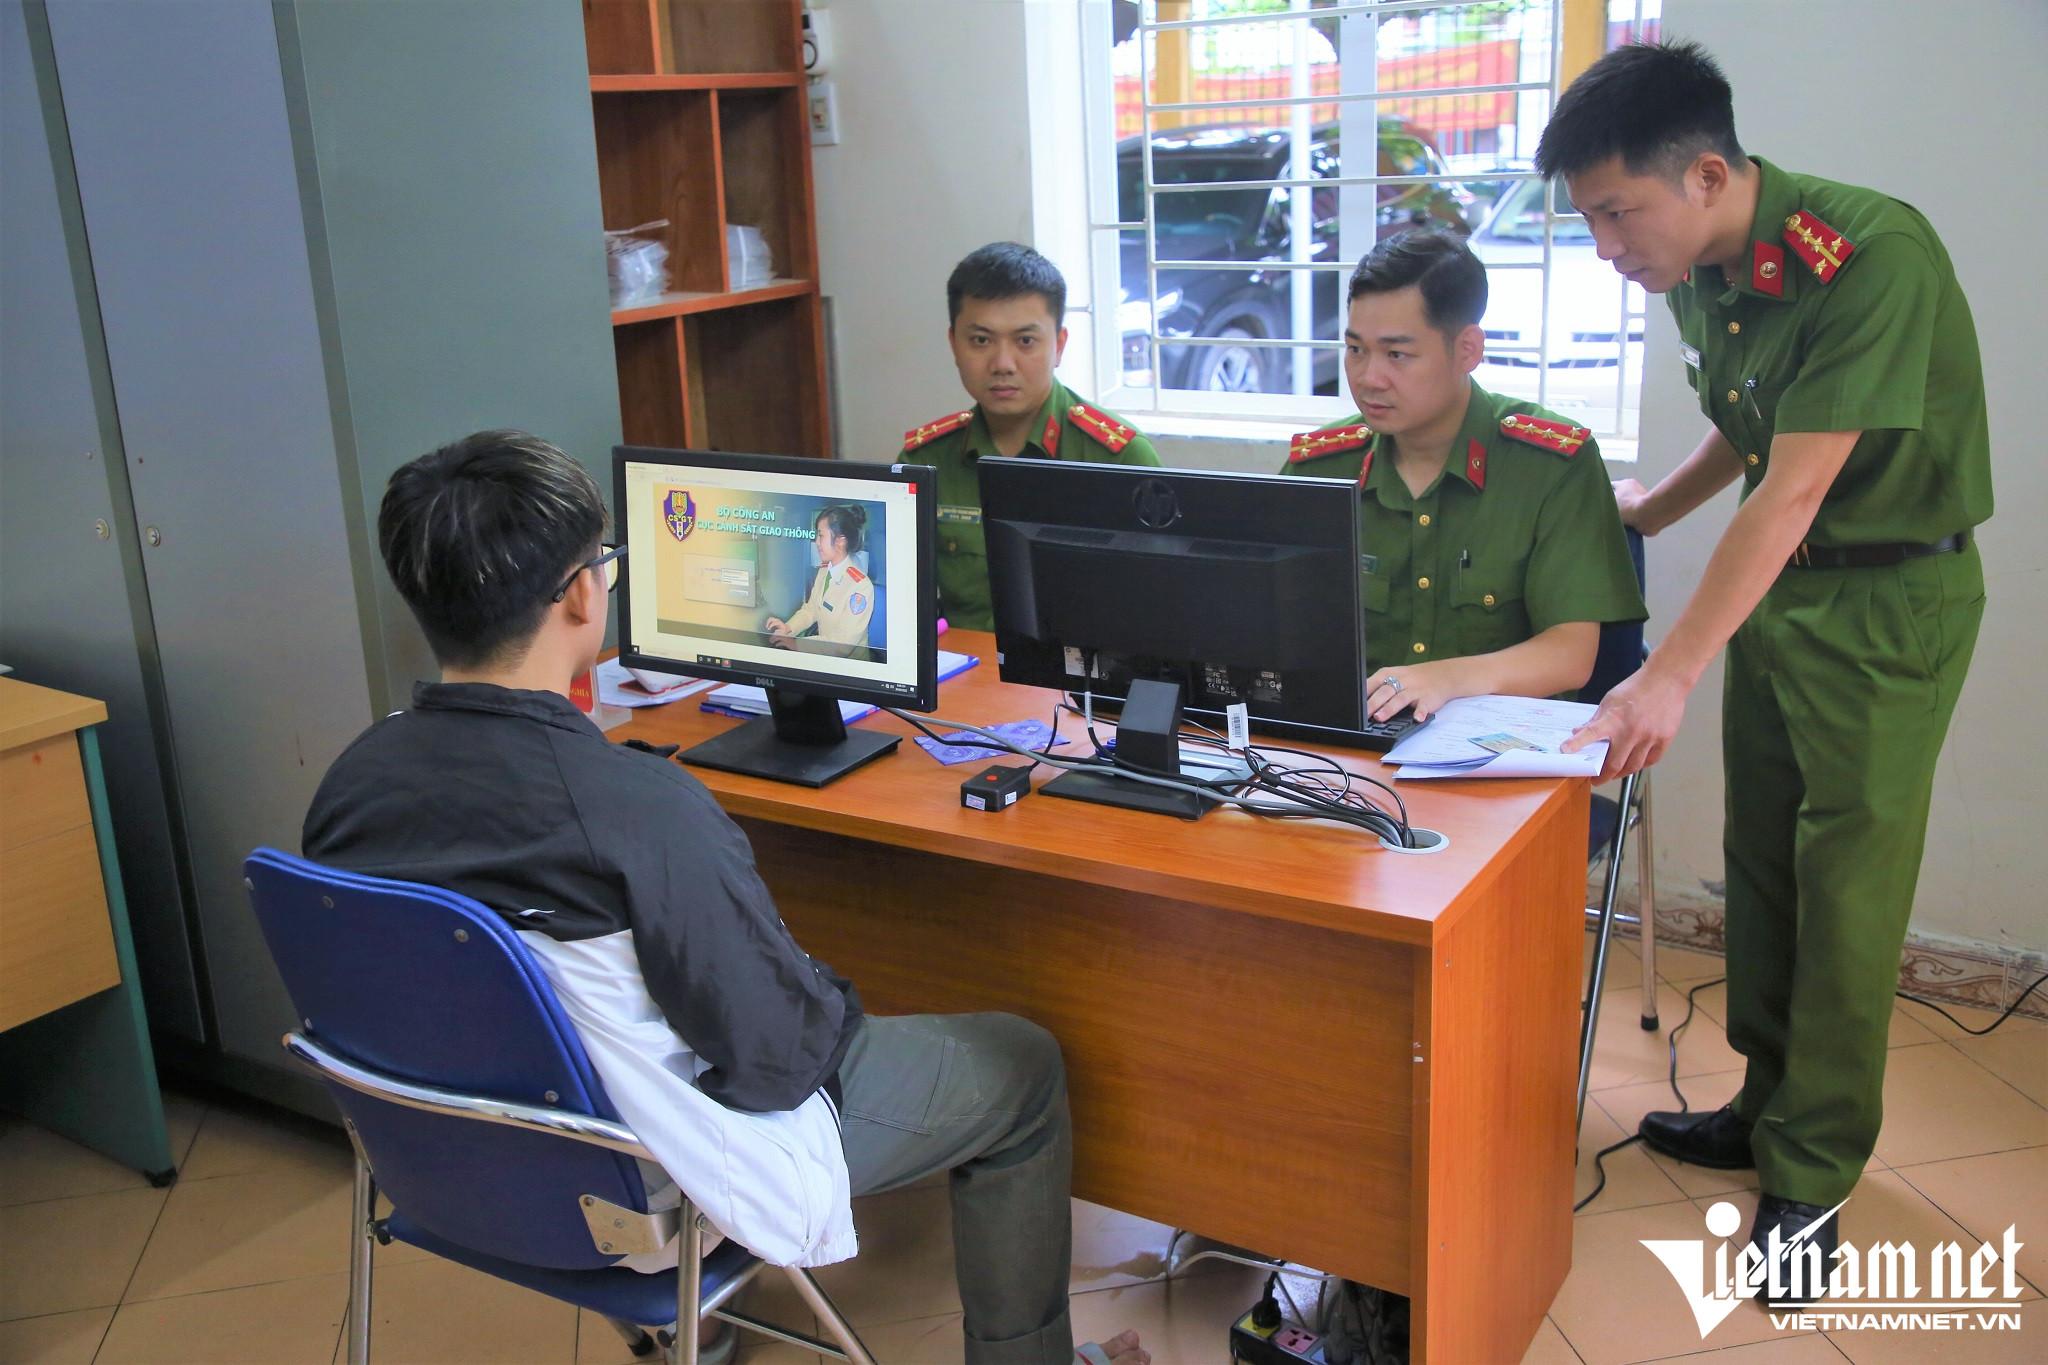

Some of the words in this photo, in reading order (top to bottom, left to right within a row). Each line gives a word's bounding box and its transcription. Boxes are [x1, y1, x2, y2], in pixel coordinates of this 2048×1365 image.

[732, 506, 760, 520] CÔNG
[761, 511, 775, 521] AN
[759, 525, 782, 537] GIAO
[783, 526, 816, 540] THÔNG
[755, 677, 776, 688] DELL
